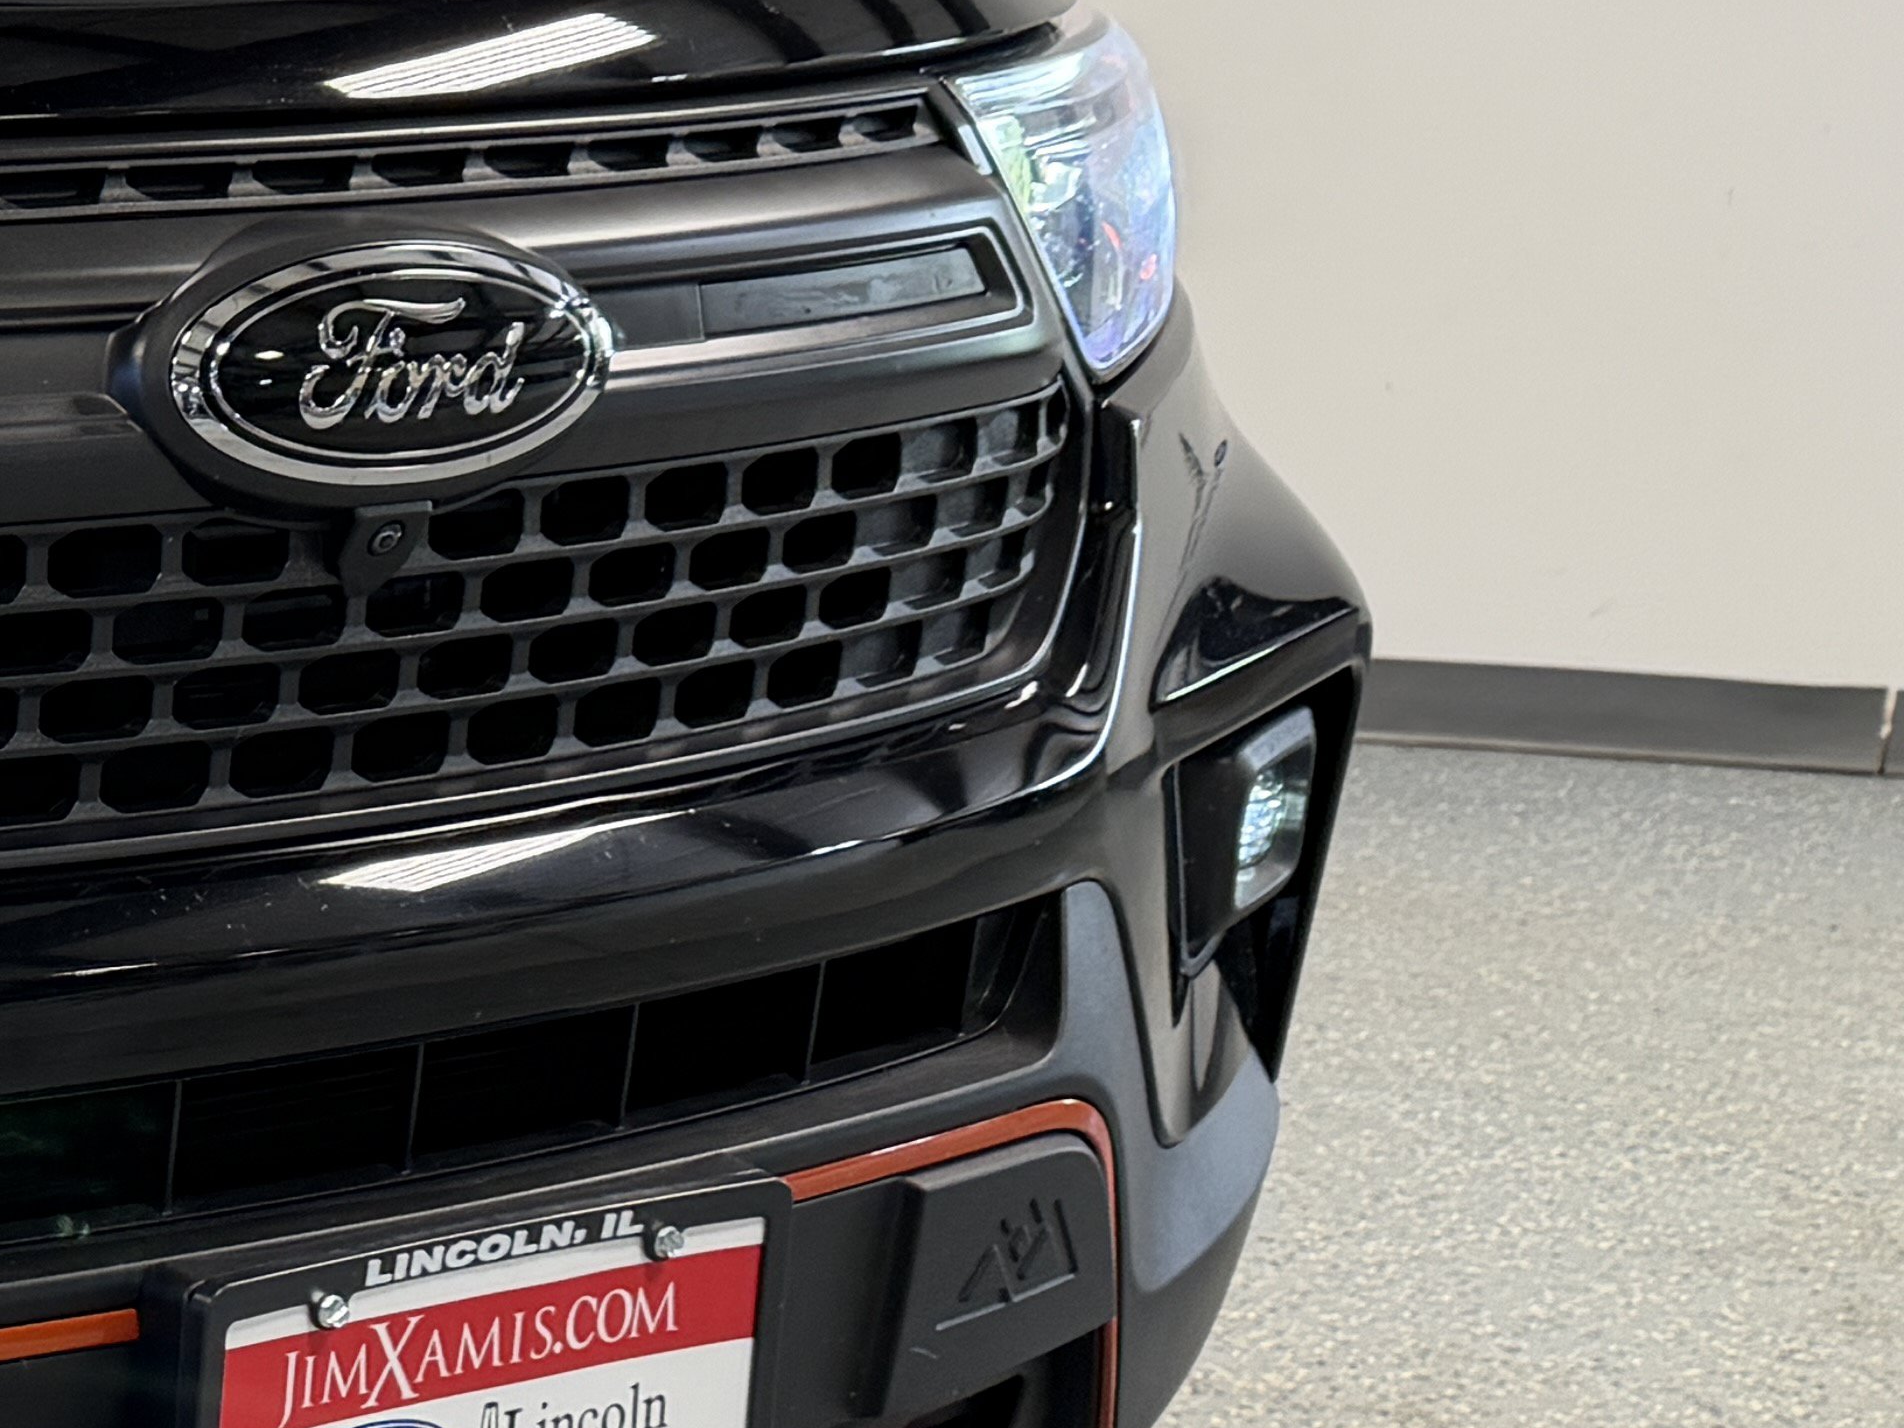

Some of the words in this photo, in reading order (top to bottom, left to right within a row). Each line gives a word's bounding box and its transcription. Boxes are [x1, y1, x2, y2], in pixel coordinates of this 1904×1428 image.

[298, 294, 526, 431] Ford
[364, 1220, 588, 1288] LINCOLN,
[600, 1208, 644, 1240] IL
